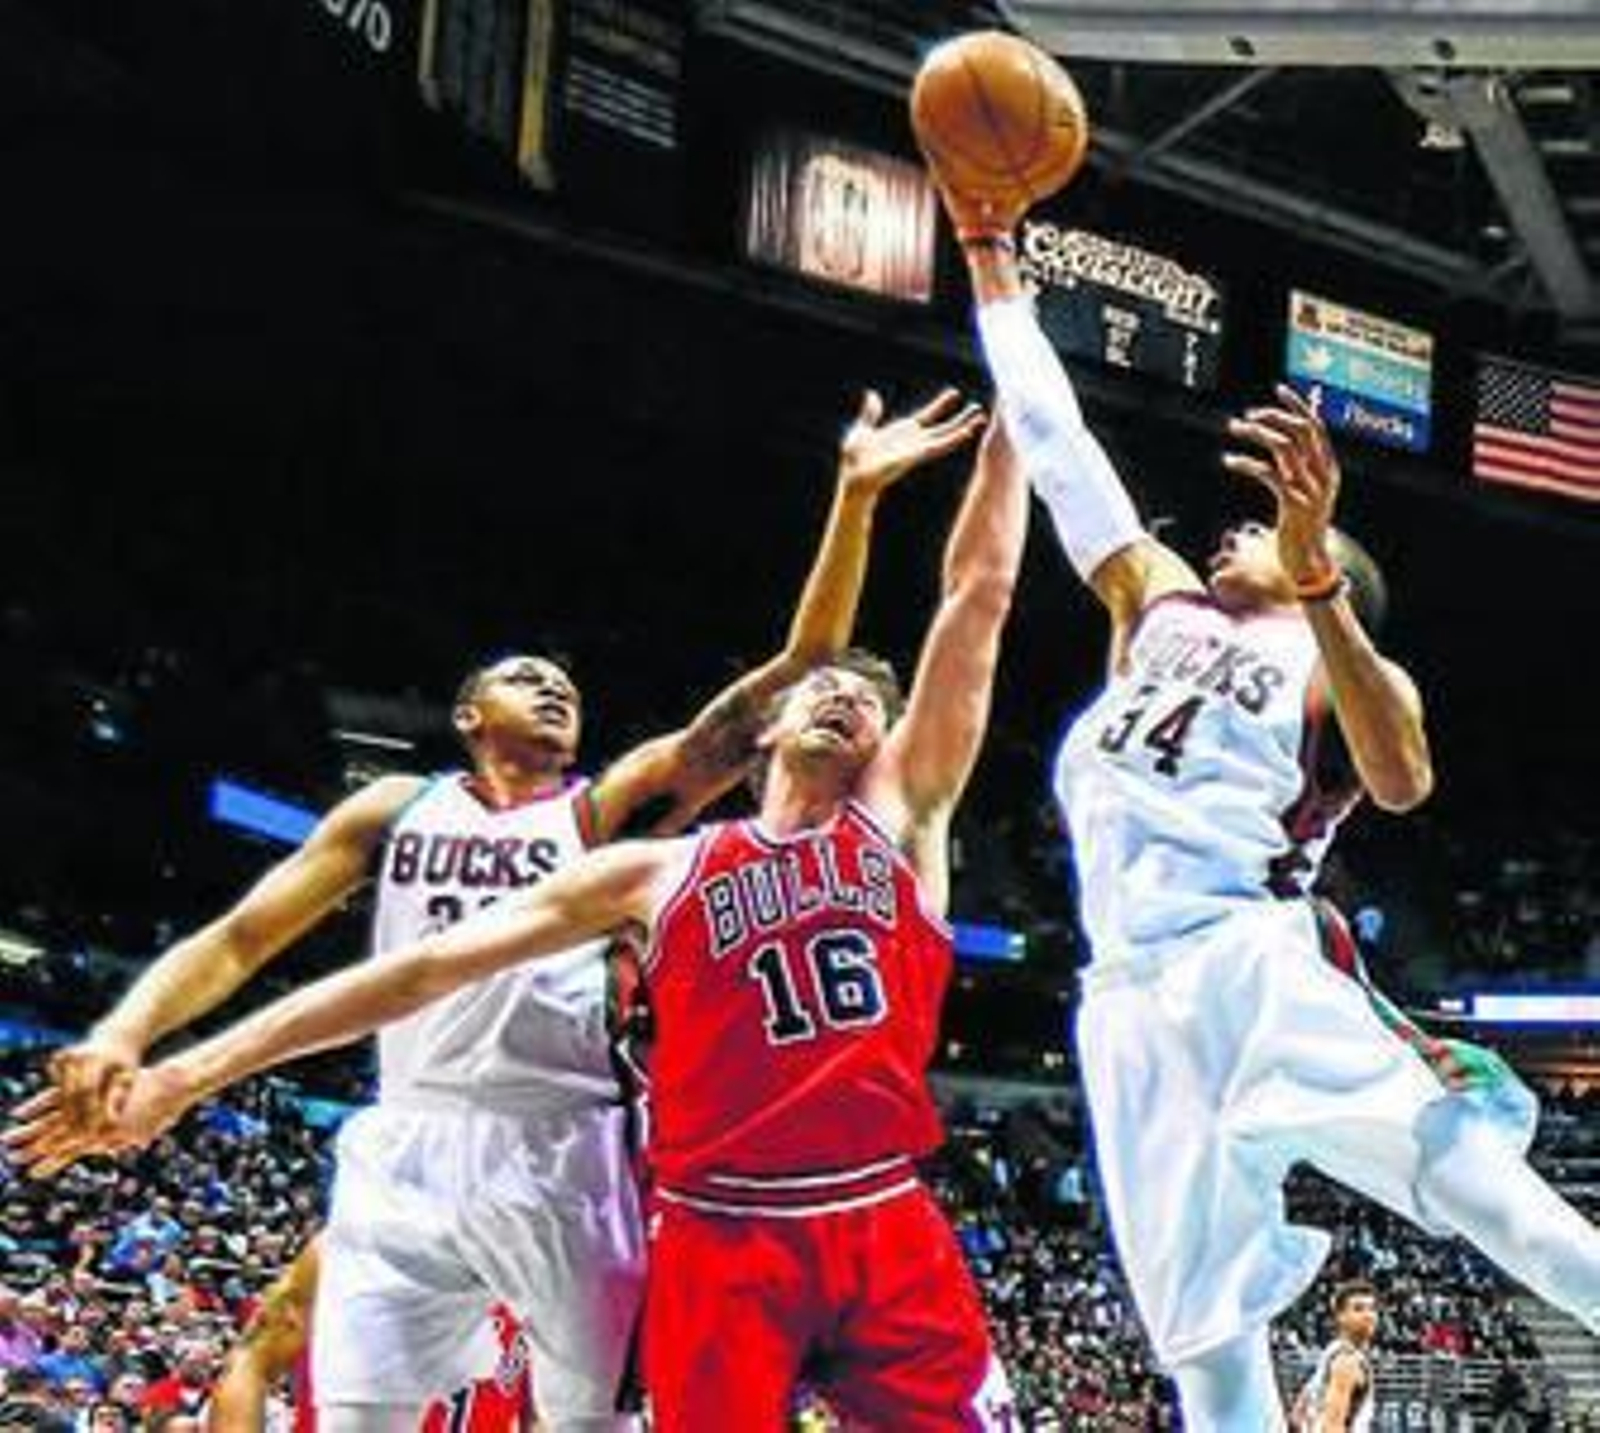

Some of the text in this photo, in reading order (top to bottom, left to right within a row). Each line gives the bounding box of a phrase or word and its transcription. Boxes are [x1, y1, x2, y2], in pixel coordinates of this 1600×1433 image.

[1098, 684, 1205, 778] 34
[391, 832, 558, 888] BUCKS
[702, 837, 897, 958] BULLS
[749, 928, 889, 1044] 16
